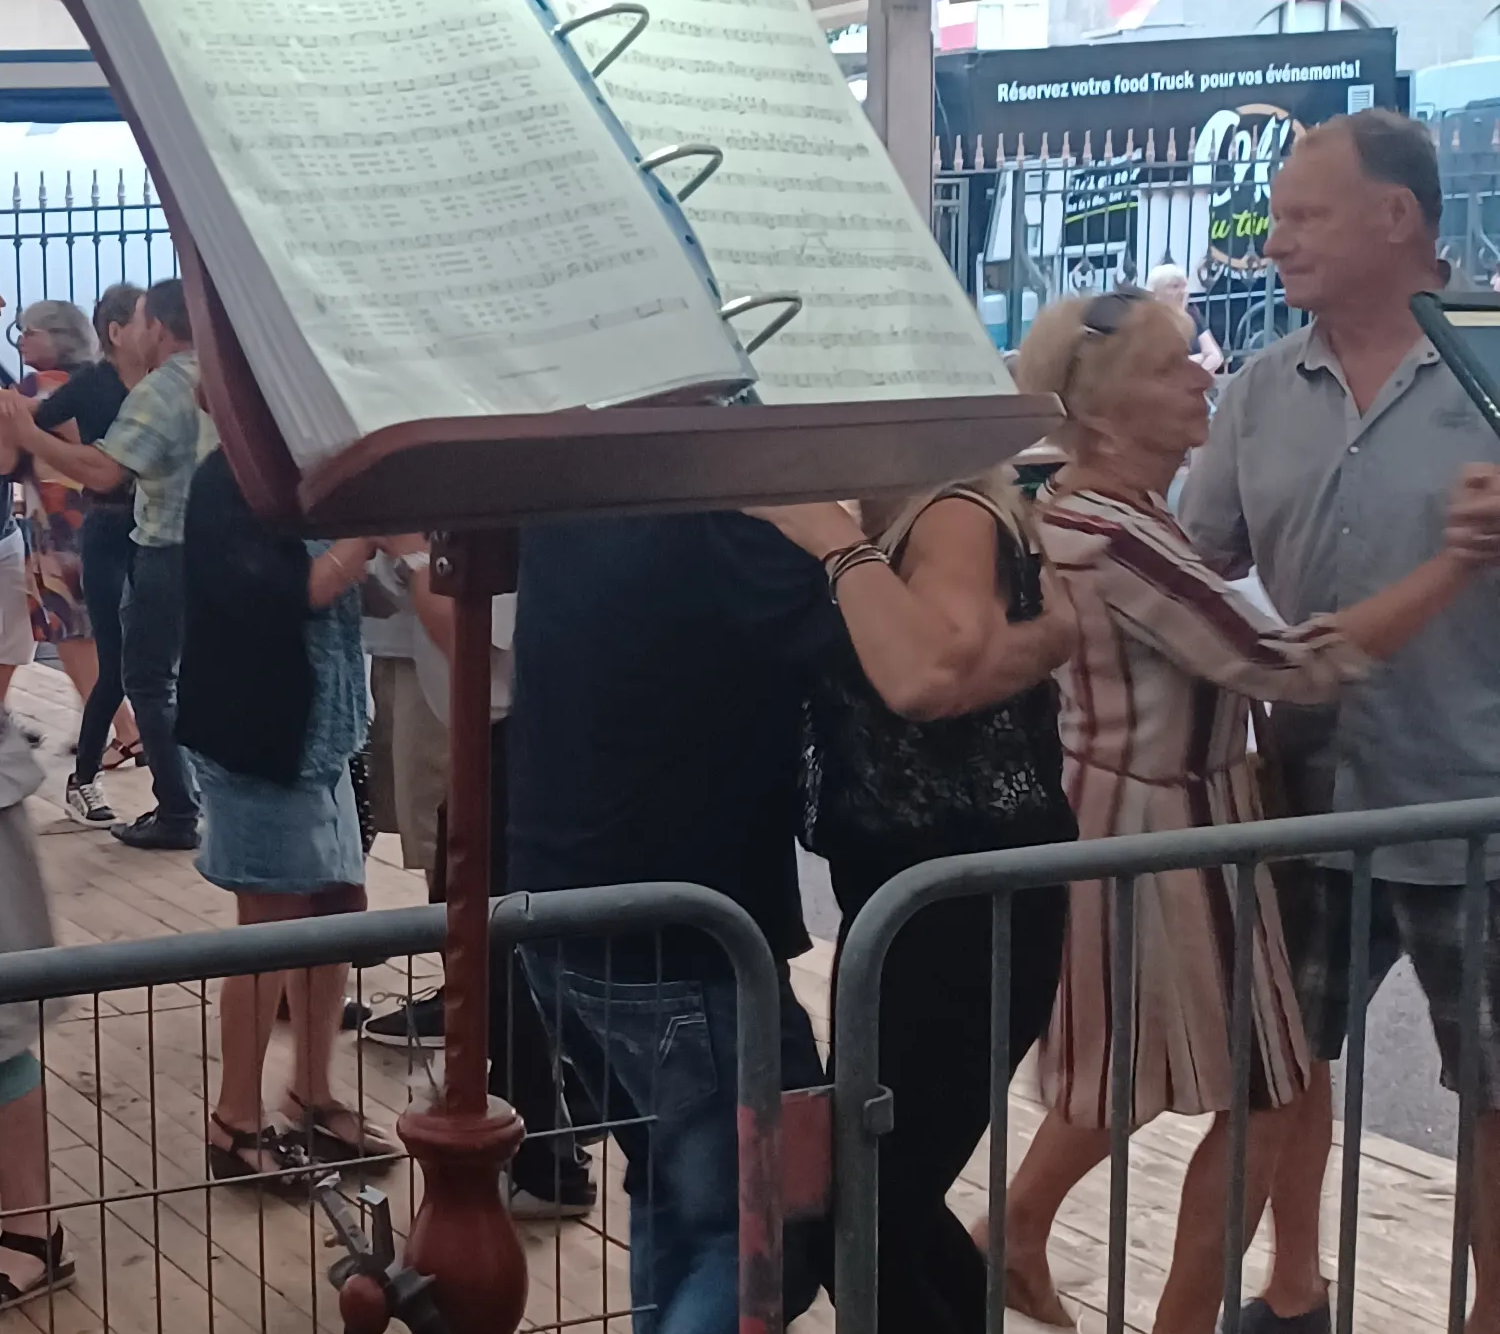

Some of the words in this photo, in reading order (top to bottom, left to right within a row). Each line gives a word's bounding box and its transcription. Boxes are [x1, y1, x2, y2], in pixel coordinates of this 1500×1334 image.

[997, 80, 1070, 103] Réservez
[1071, 77, 1111, 97] votre
[1114, 72, 1150, 94] food
[1151, 70, 1195, 91] Truck
[1200, 71, 1237, 93] pour
[1238, 69, 1263, 86] vos
[1265, 59, 1361, 85] événements!
